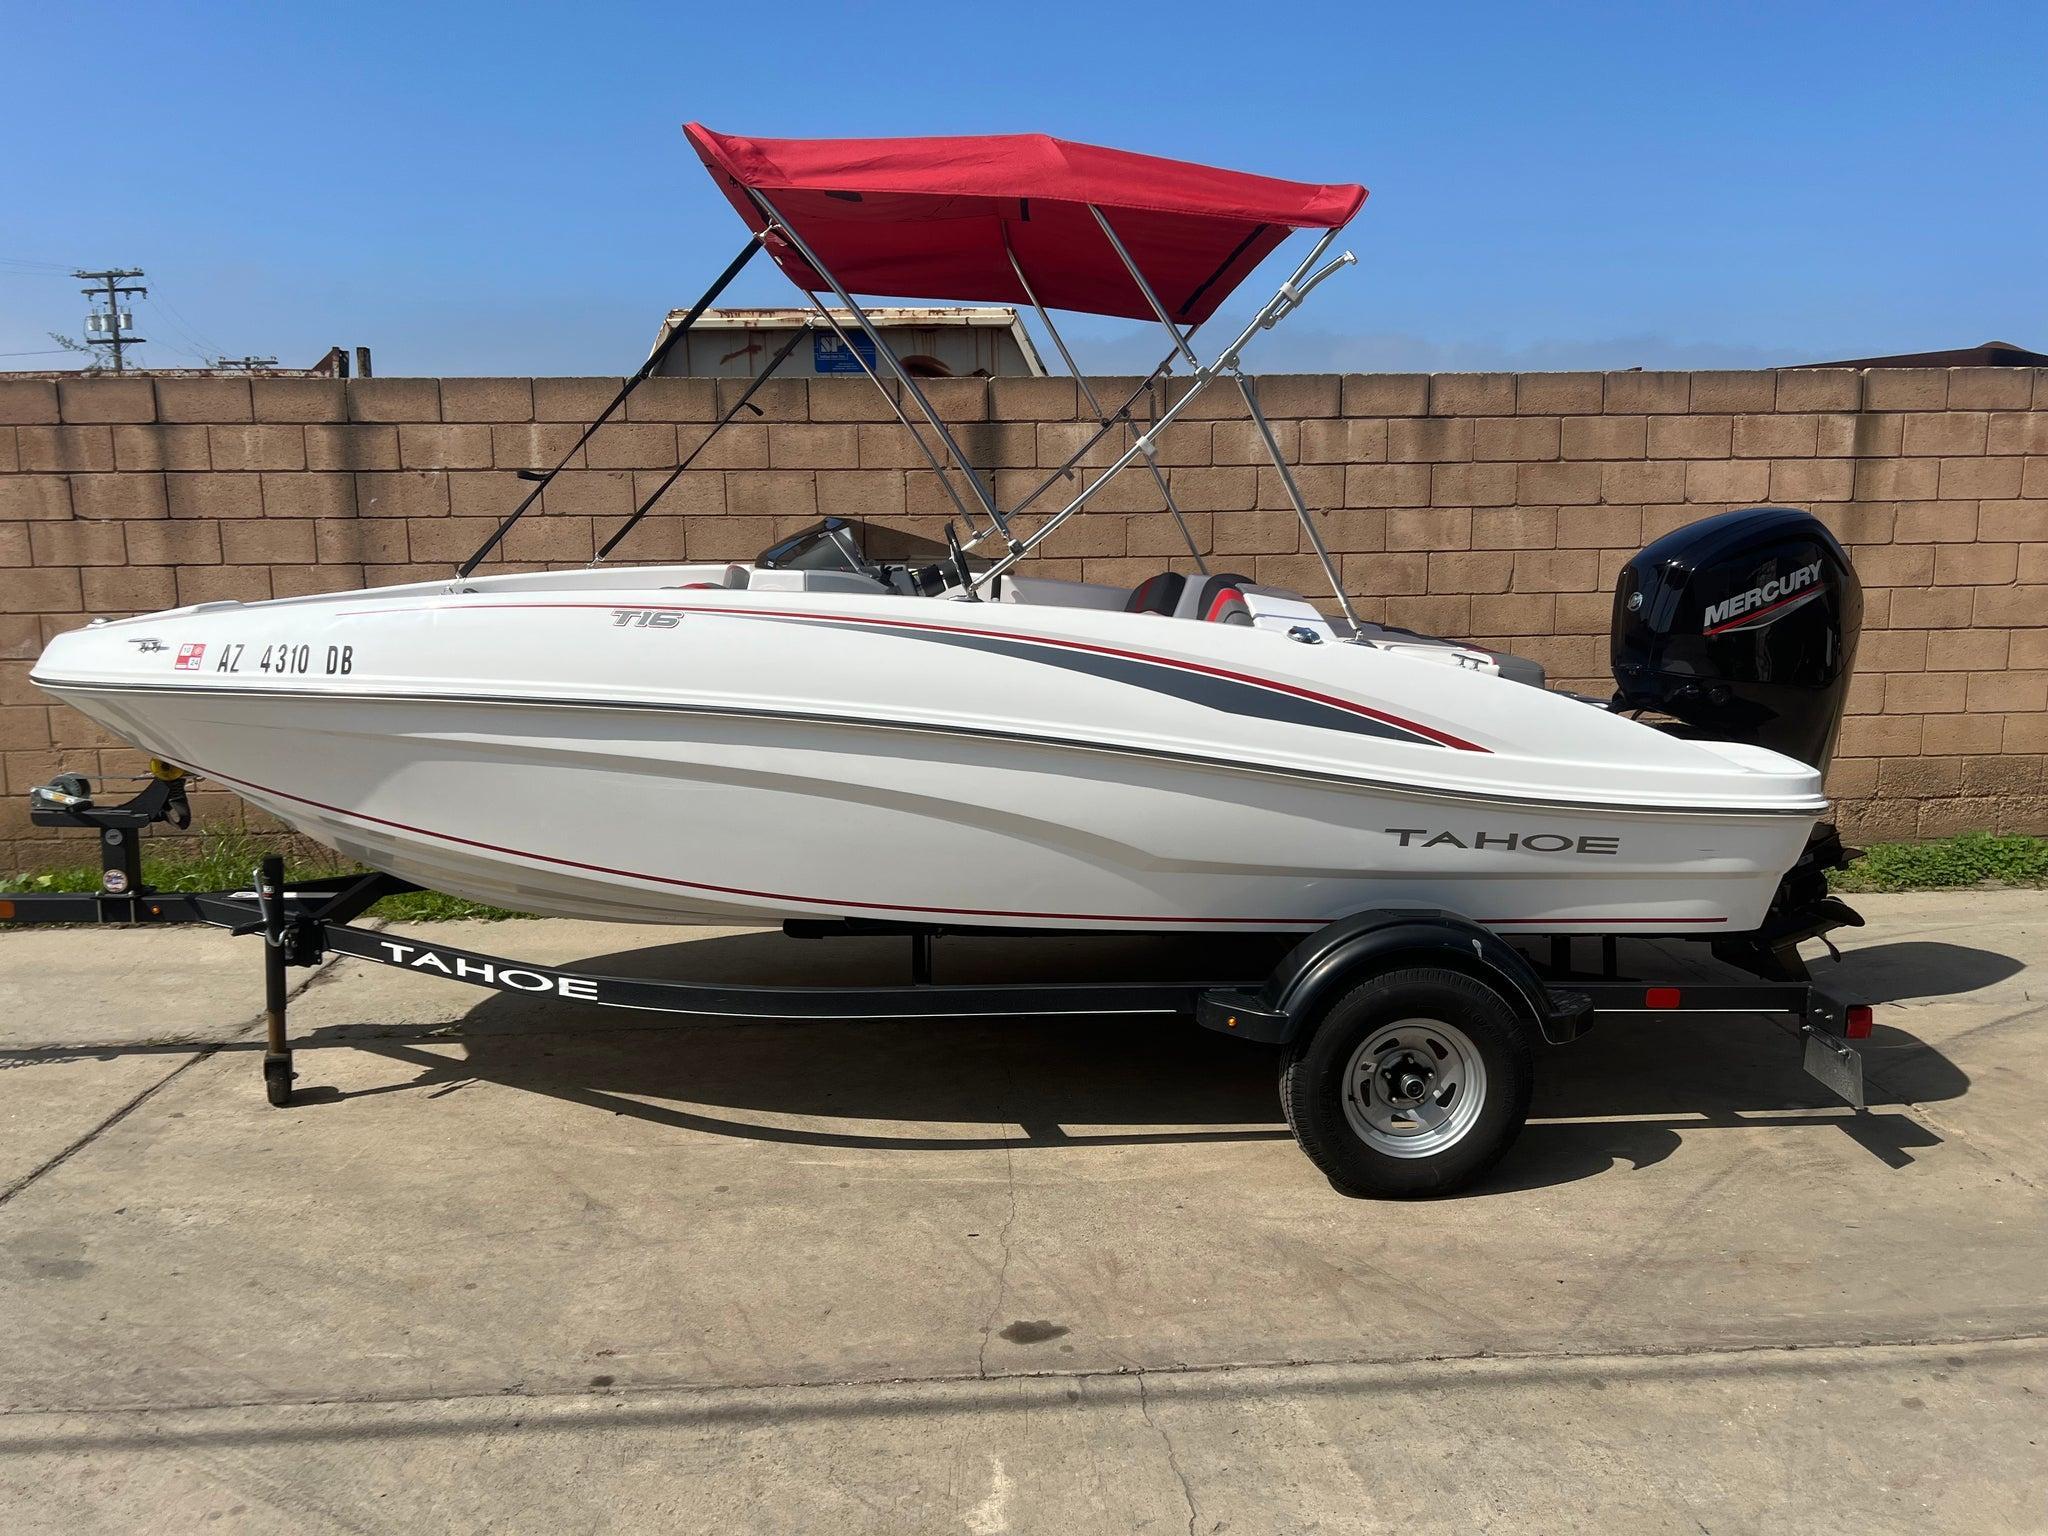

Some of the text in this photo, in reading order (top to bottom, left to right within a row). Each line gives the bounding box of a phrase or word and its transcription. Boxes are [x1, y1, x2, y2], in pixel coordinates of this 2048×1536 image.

[1704, 559, 1823, 627] MERCURY
[611, 609, 685, 629] T16
[216, 643, 353, 675] AZ 4310 DB
[1384, 828, 1620, 855] TAHOE
[380, 941, 599, 1001] TAHOE
